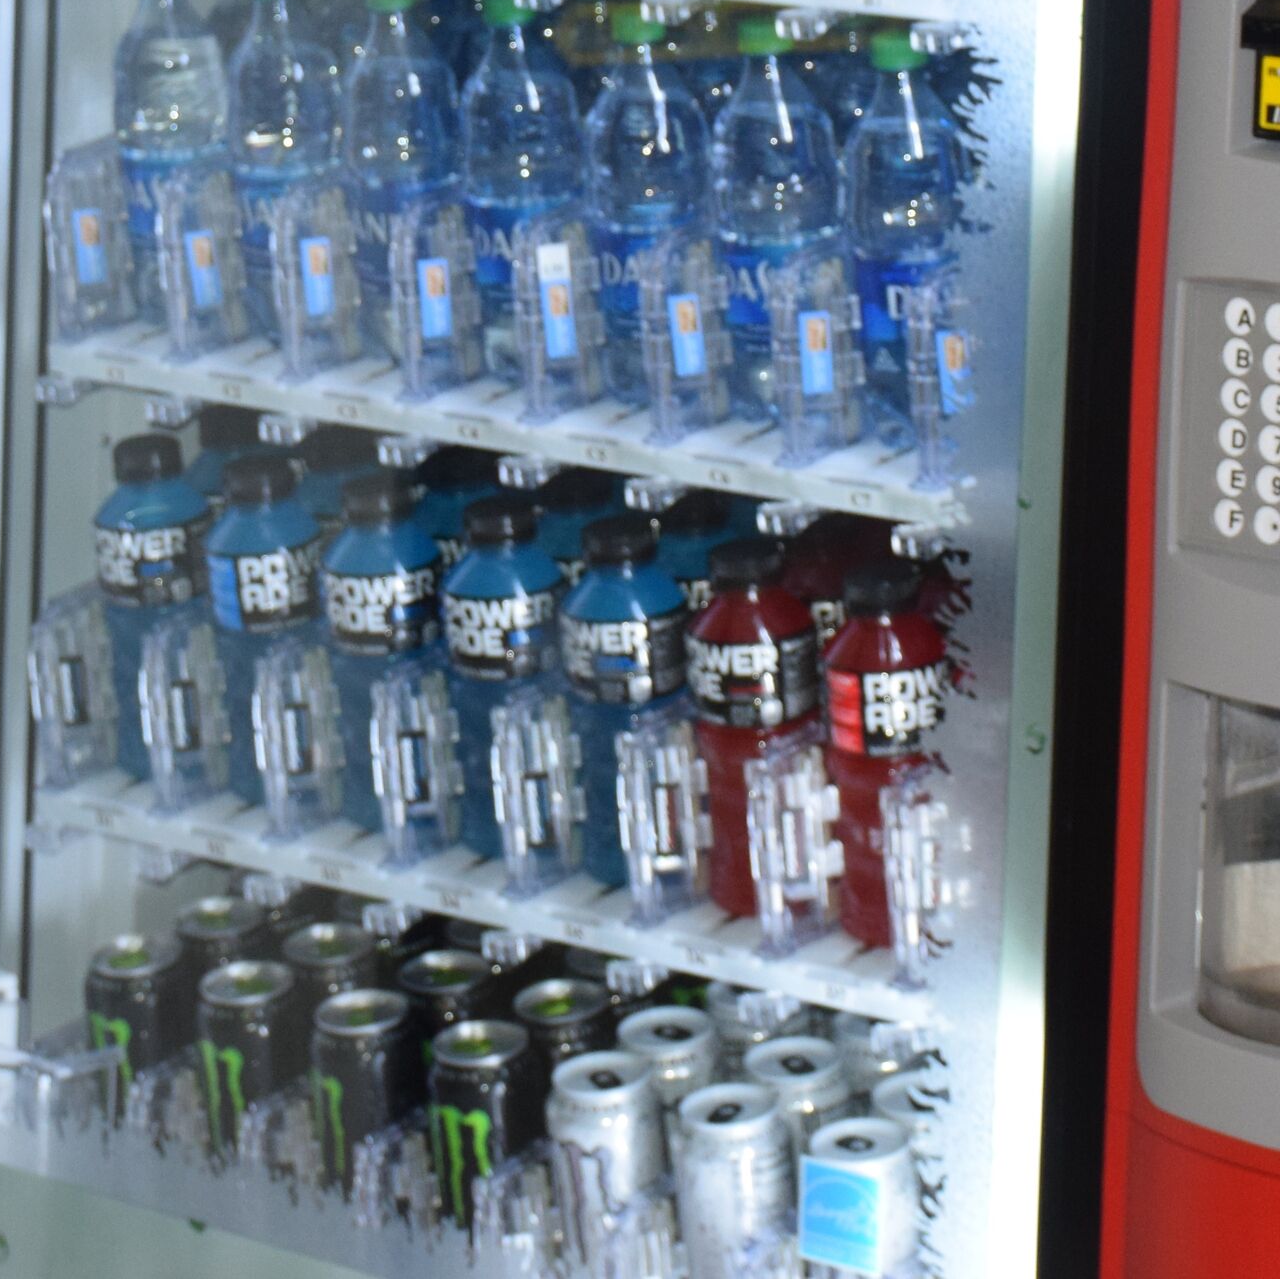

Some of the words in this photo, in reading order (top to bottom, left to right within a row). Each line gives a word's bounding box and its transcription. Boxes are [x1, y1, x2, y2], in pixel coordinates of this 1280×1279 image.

[1236, 308, 1253, 329] A
[1236, 348, 1251, 369] B
[1233, 388, 1249, 410] C
[1231, 429, 1247, 450] D
[1231, 469, 1246, 490] E
[1228, 509, 1244, 529] F
